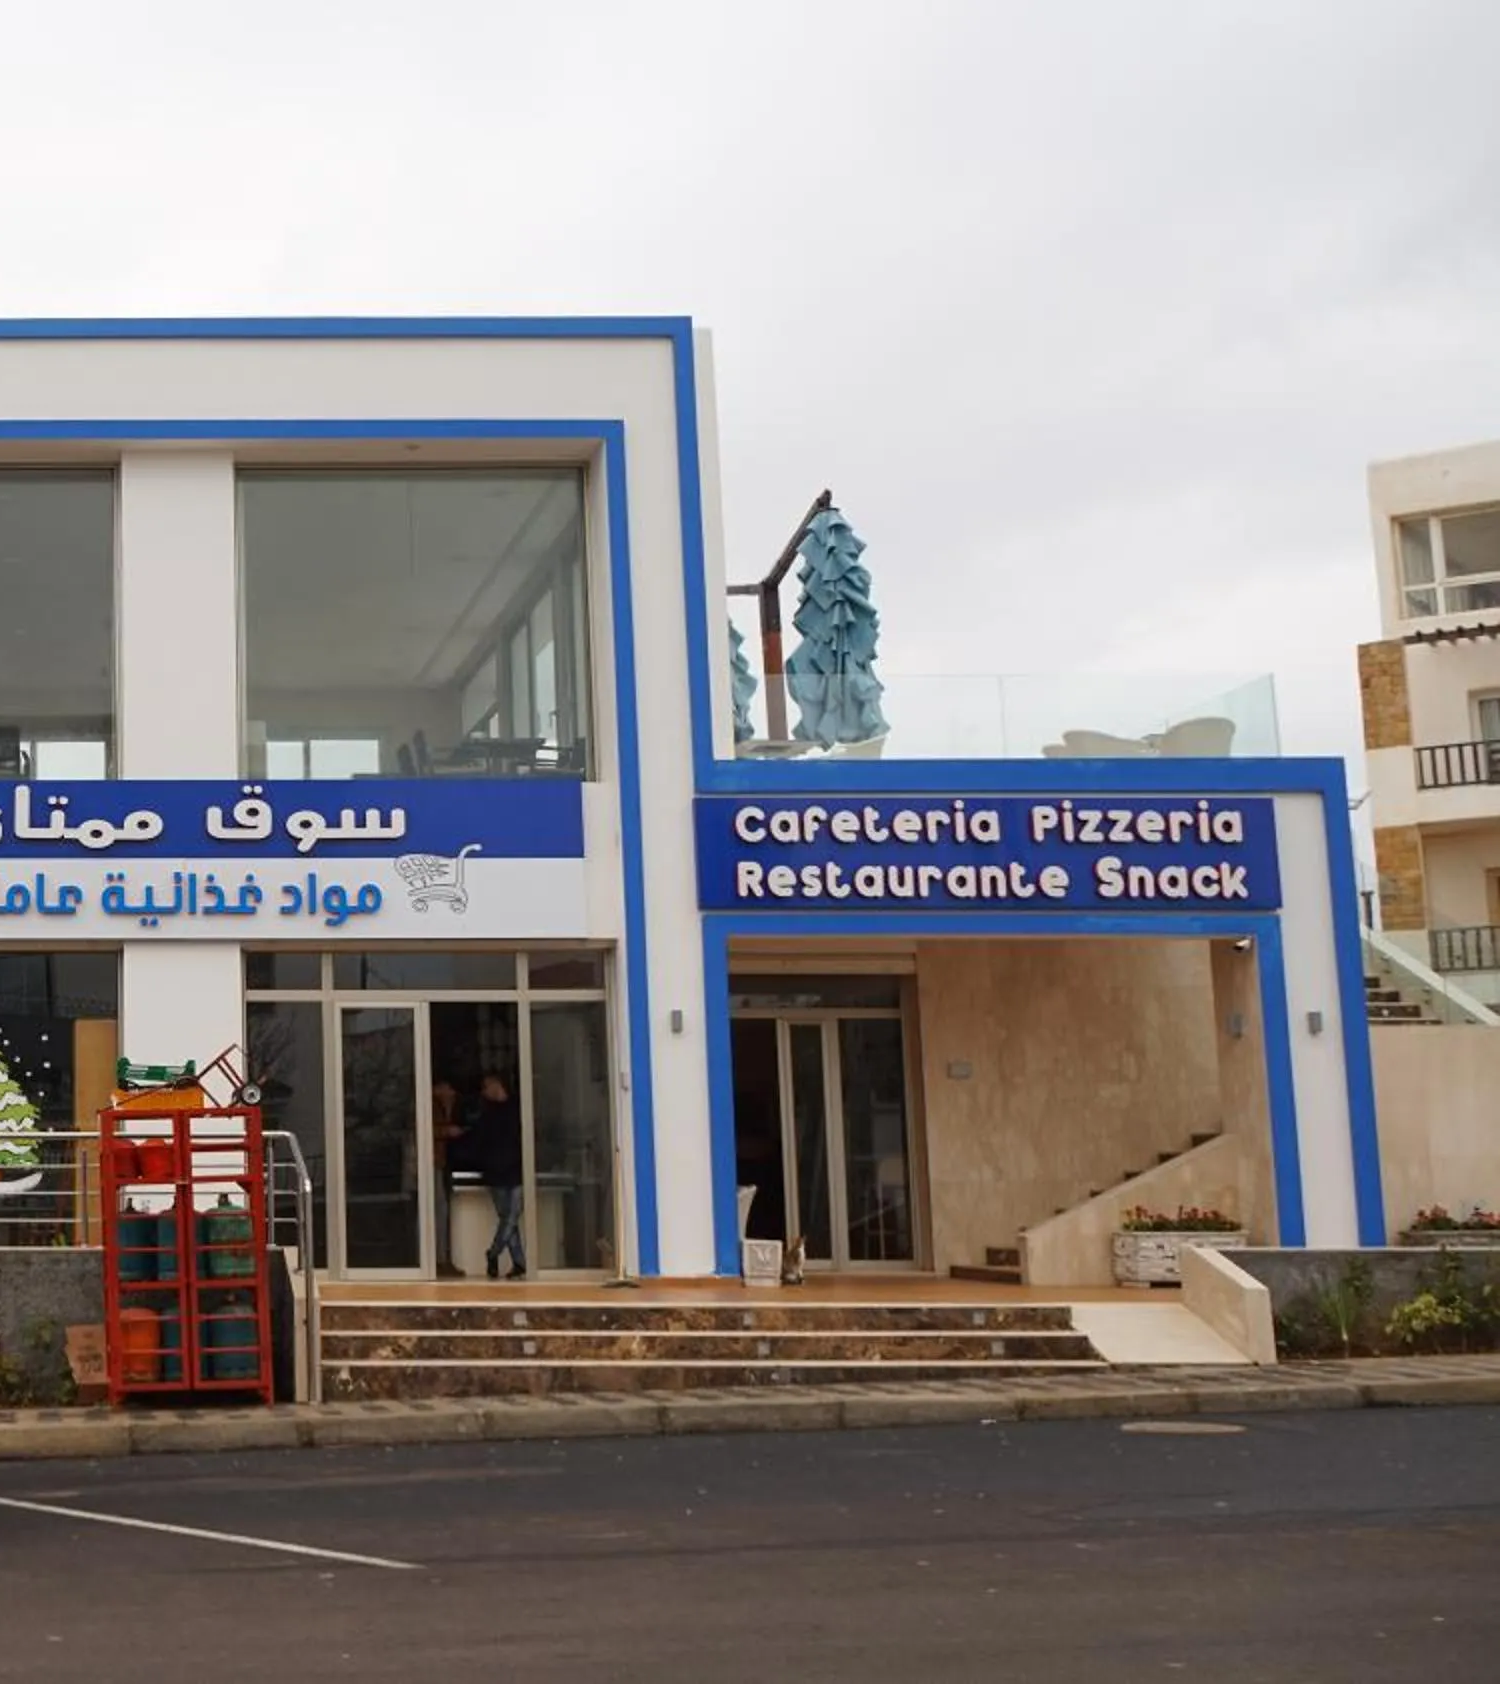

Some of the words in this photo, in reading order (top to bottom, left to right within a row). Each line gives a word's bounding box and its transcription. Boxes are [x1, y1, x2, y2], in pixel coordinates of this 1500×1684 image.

[206, 785, 406, 853] سوق
[735, 800, 1001, 843] Cafeteria
[1032, 799, 1244, 843] Pizzeria
[280, 872, 384, 926] مواد
[736, 861, 1071, 898] Restaurante
[1095, 856, 1250, 899] Snack
